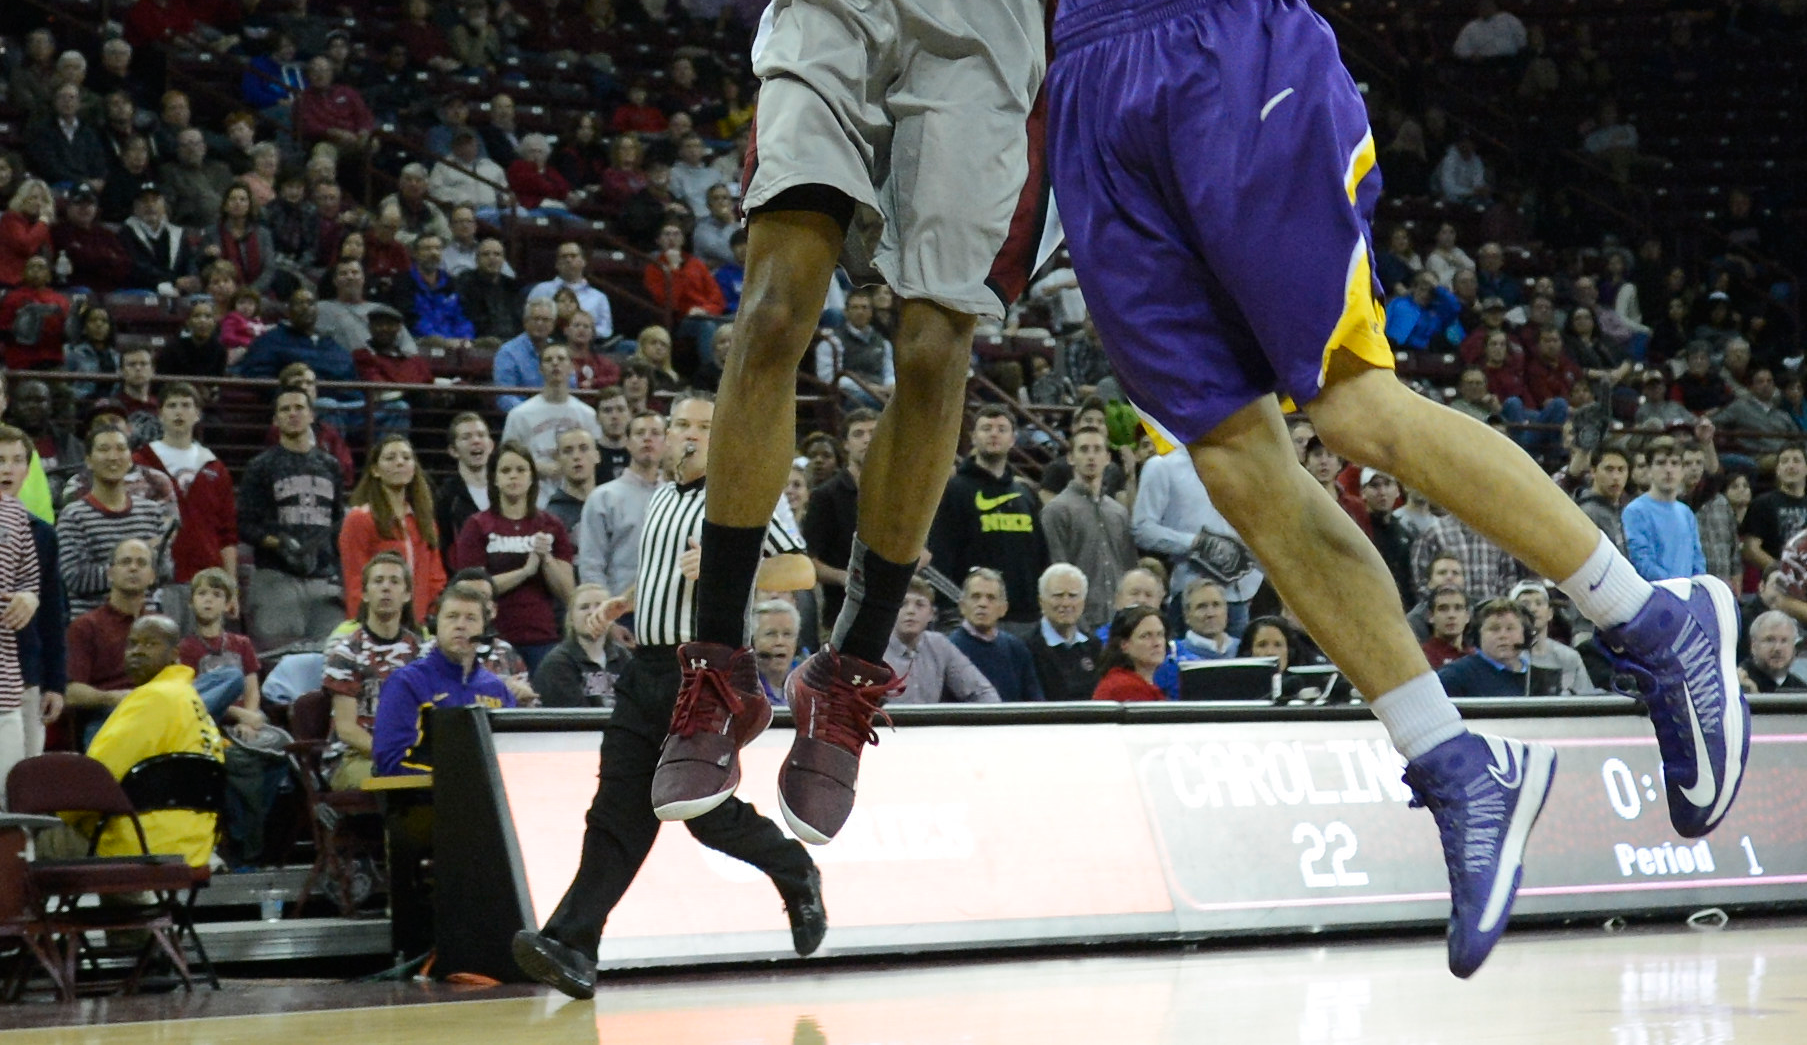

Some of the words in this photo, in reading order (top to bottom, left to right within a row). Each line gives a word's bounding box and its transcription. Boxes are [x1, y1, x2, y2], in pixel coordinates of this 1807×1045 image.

[980, 513, 1034, 533] NIKE
[1602, 758, 1667, 820] 0:
[1292, 821, 1370, 888] 22
[1613, 840, 1716, 877] Period
[1740, 836, 1764, 876] 1
